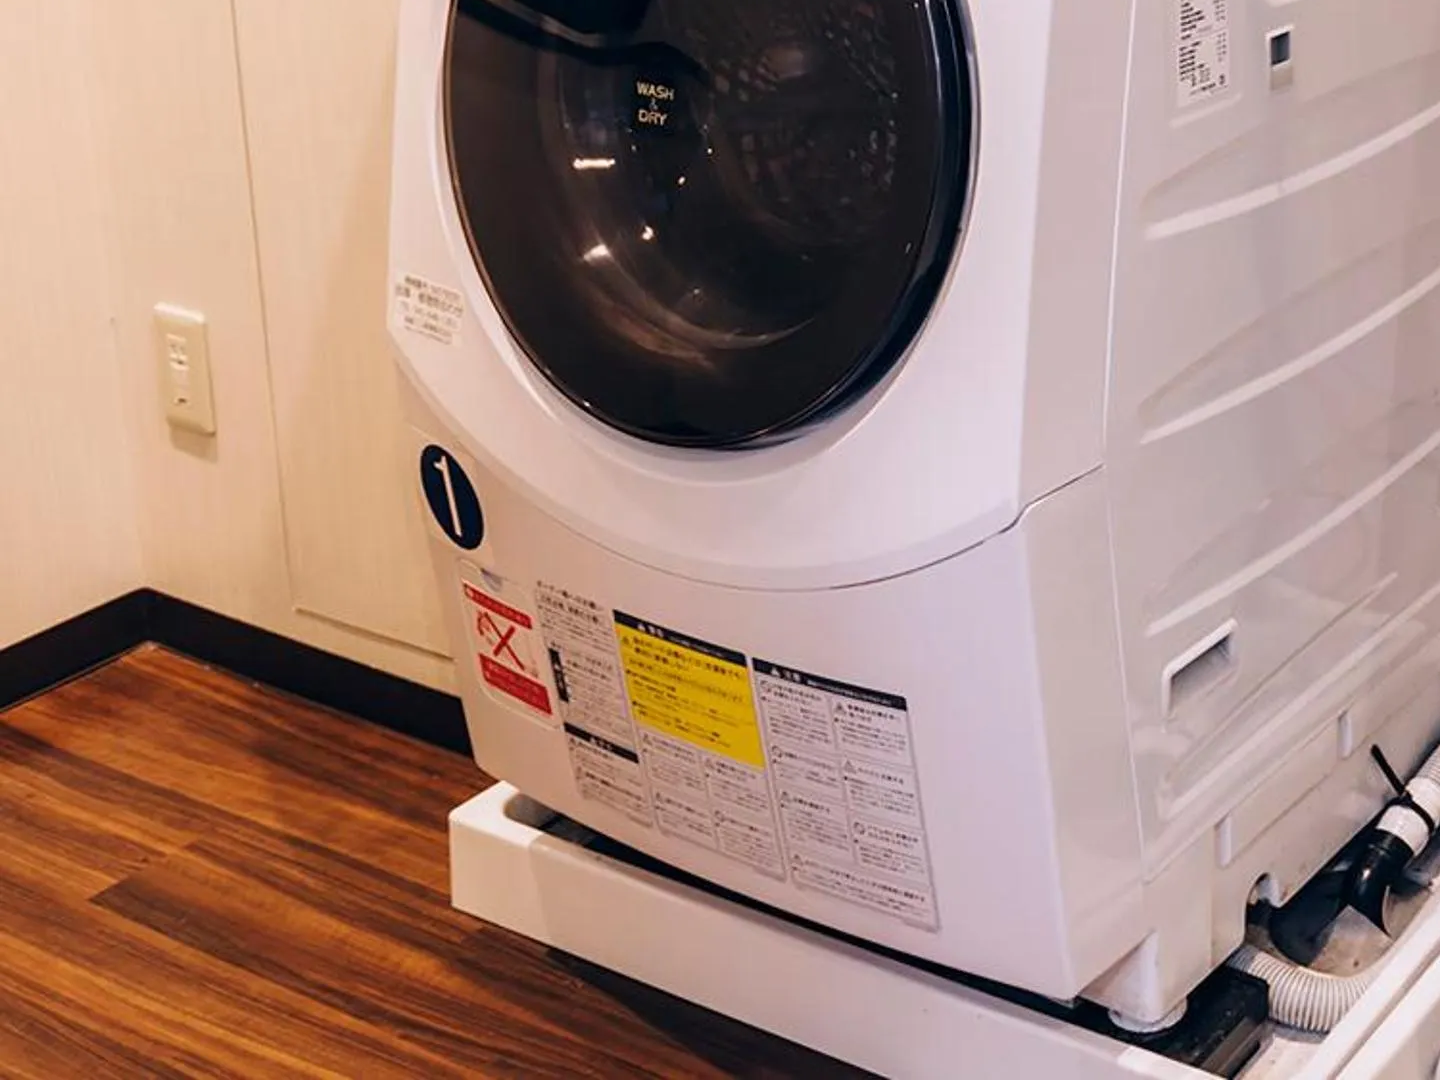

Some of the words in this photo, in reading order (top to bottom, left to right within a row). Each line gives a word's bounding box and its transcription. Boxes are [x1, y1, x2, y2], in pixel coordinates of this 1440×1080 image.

[636, 80, 675, 101] WASH
[638, 108, 668, 126] DRY
[433, 455, 463, 538] 1
